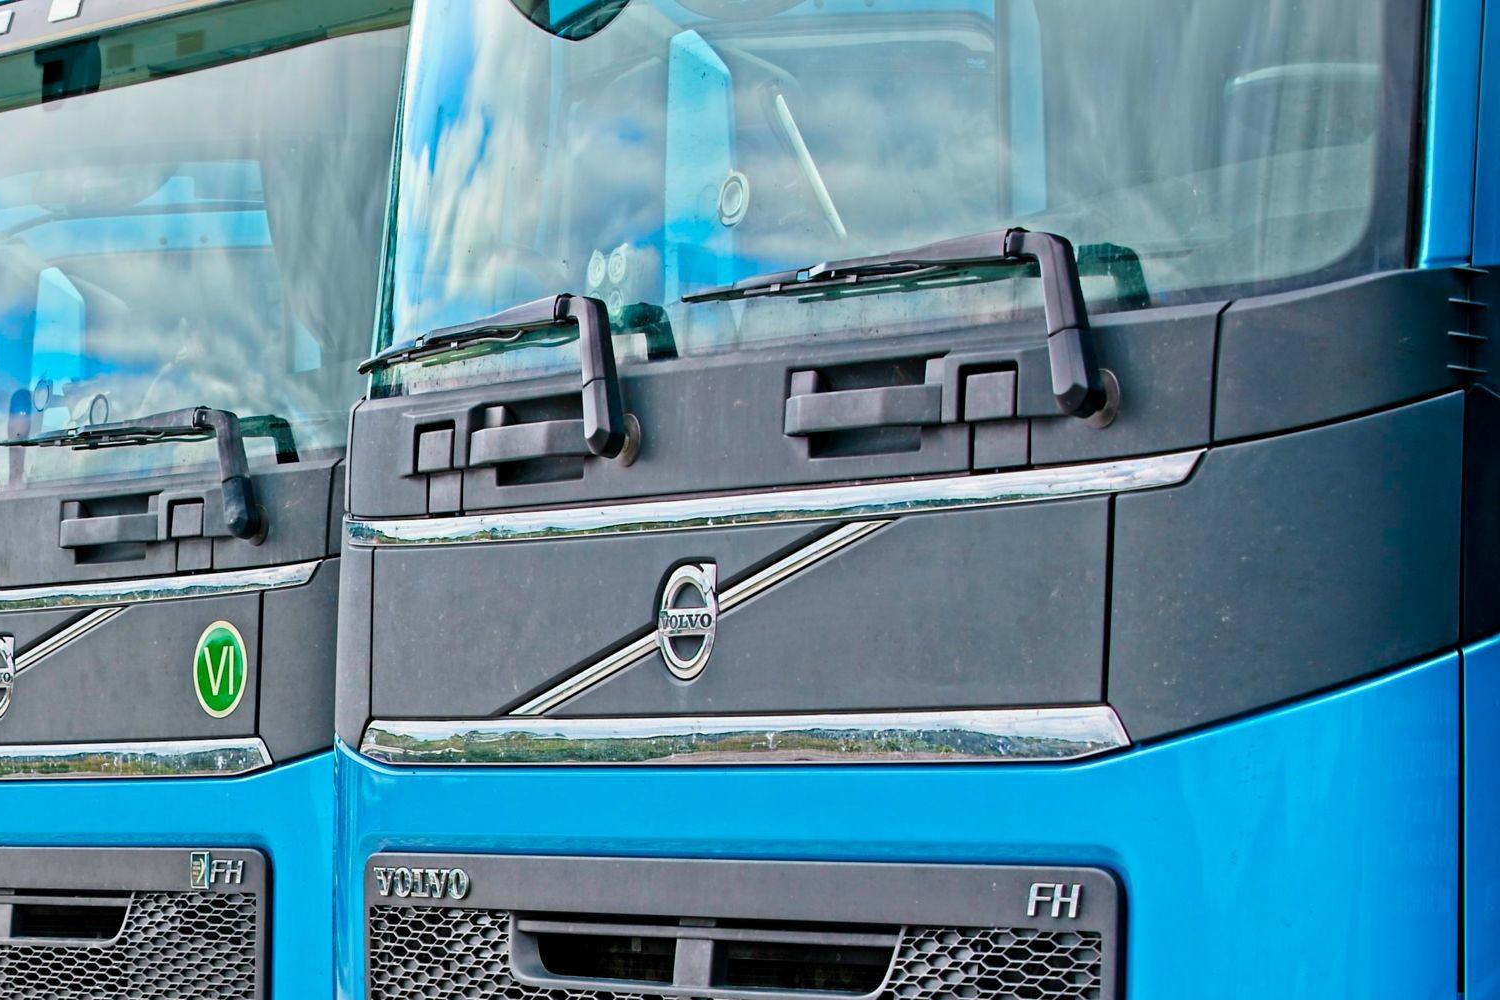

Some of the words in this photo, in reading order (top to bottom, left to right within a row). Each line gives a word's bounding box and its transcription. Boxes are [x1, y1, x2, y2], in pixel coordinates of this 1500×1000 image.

[660, 612, 713, 630] VOLVO
[203, 646, 235, 697] VI
[209, 859, 244, 884] FH
[373, 866, 471, 902] VOLVO
[1026, 881, 1082, 919] FH
